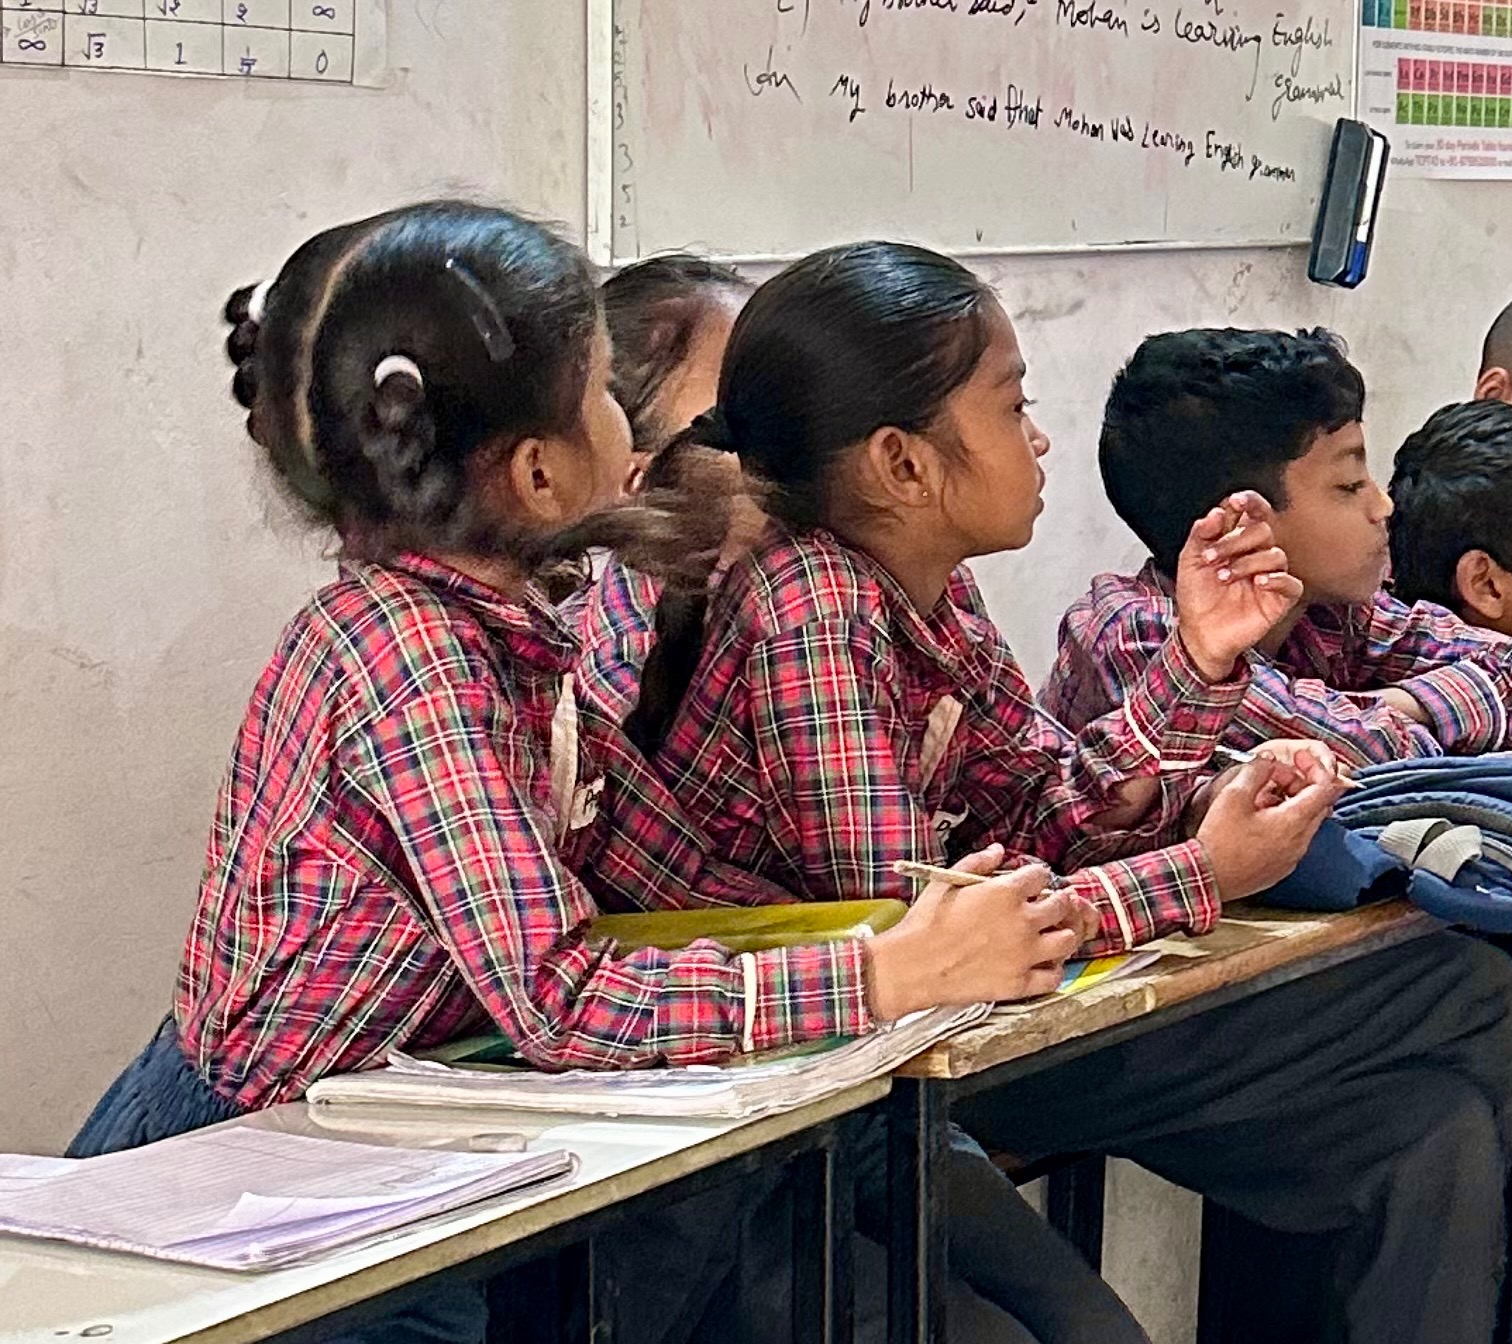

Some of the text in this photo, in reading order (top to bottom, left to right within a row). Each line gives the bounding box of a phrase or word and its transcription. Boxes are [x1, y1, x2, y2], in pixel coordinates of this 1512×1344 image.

[1140, 8, 1162, 36] is
[1271, 12, 1334, 78] English
[829, 73, 867, 124] My
[884, 77, 956, 113] brother
[1053, 106, 1105, 141] Mohan
